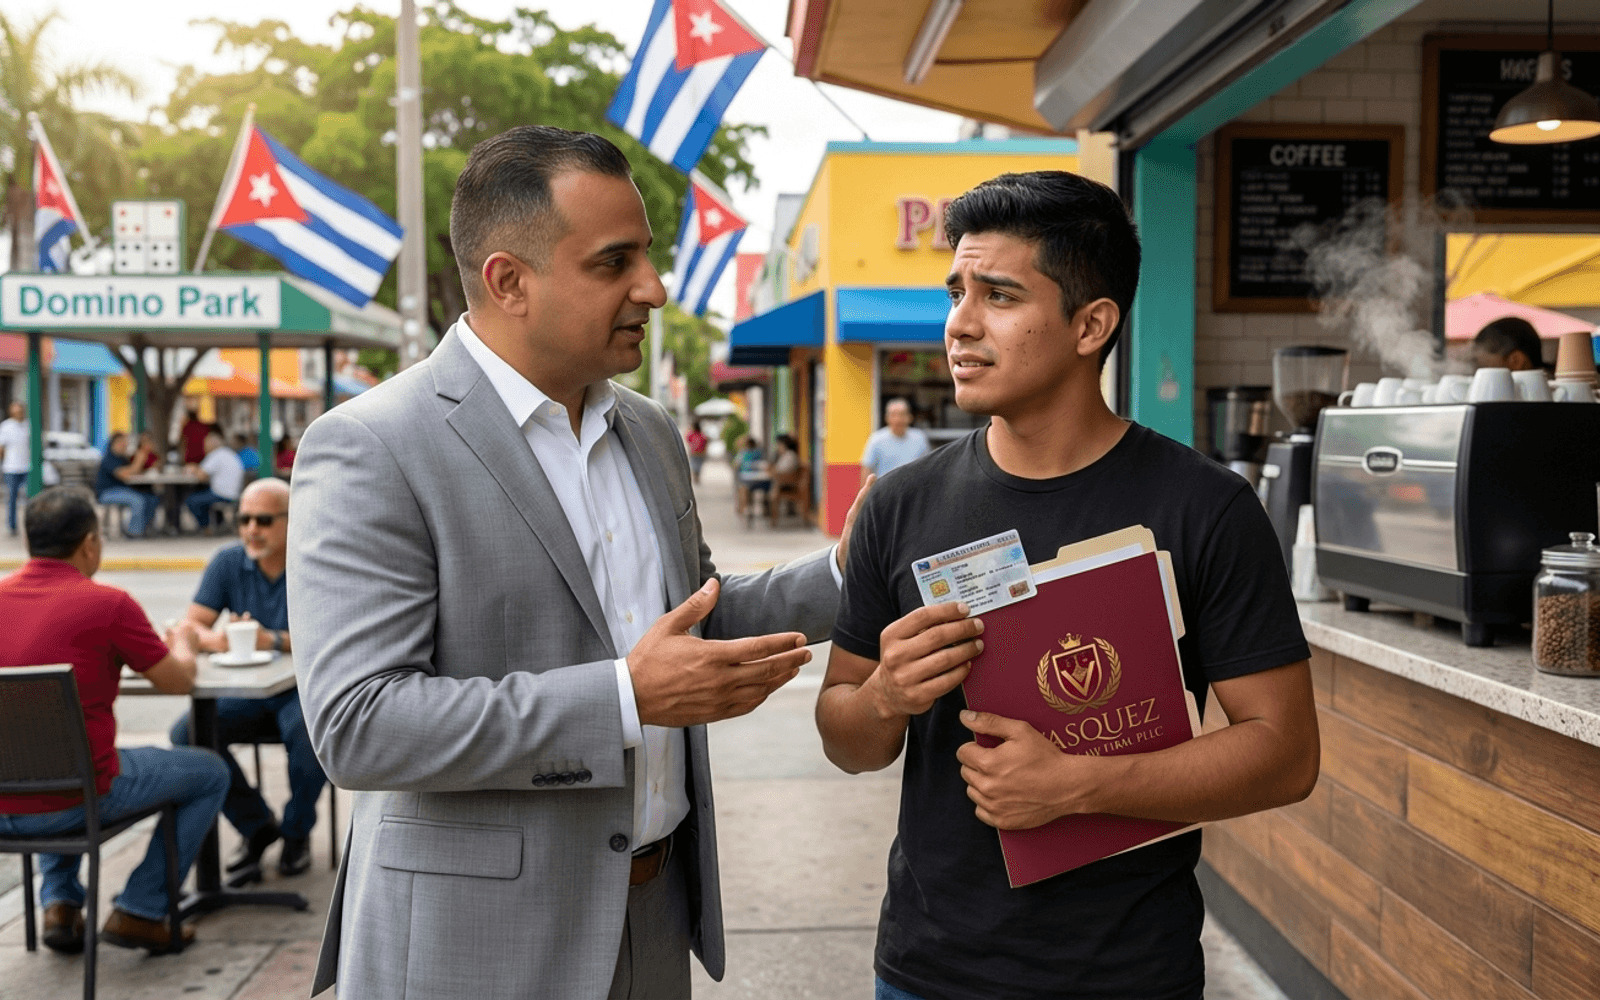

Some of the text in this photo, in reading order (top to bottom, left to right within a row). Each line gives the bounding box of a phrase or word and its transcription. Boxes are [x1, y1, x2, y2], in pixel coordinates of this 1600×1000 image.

[1269, 144, 1347, 167] COFFEE
[20, 285, 262, 317] Domino Park
[1042, 697, 1161, 749] ASQUEZ
[1103, 736, 1133, 753] FIRM
[1136, 725, 1164, 743] PLLC
